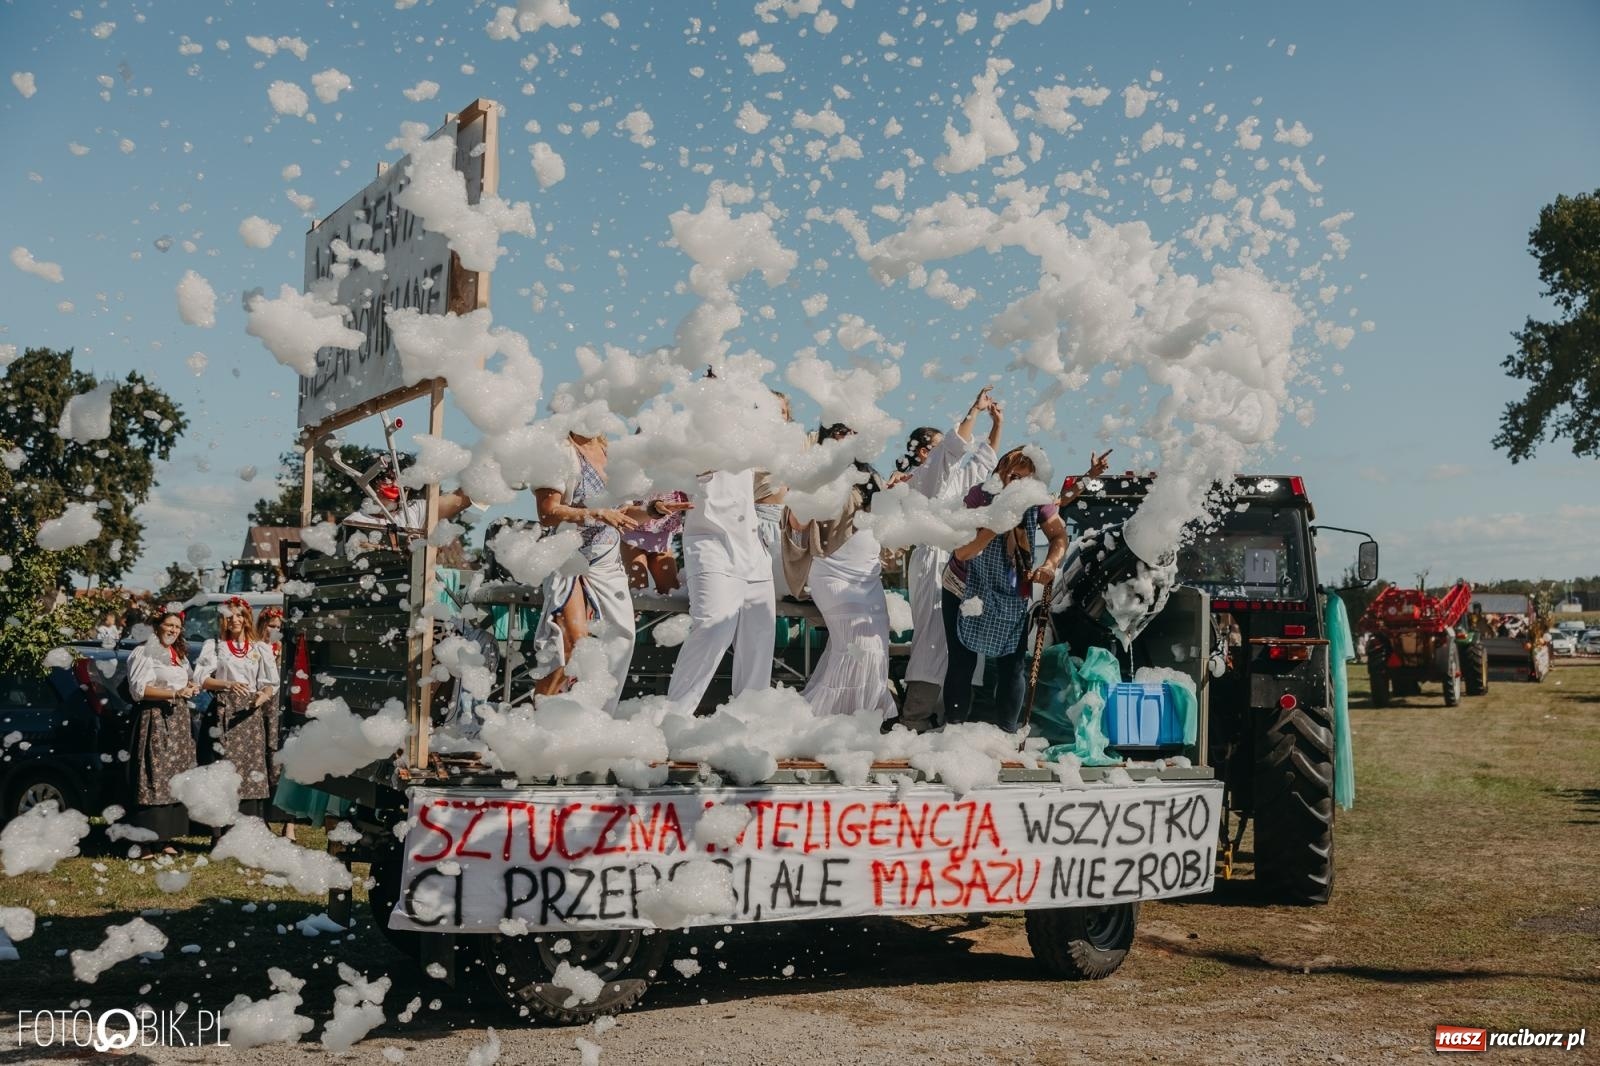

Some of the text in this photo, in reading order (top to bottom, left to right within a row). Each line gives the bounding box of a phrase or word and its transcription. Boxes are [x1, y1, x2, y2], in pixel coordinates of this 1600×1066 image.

[413, 794, 1210, 863] SZTUCZNA TELIGENCJA WSZYSTKO
[404, 864, 464, 926] CI
